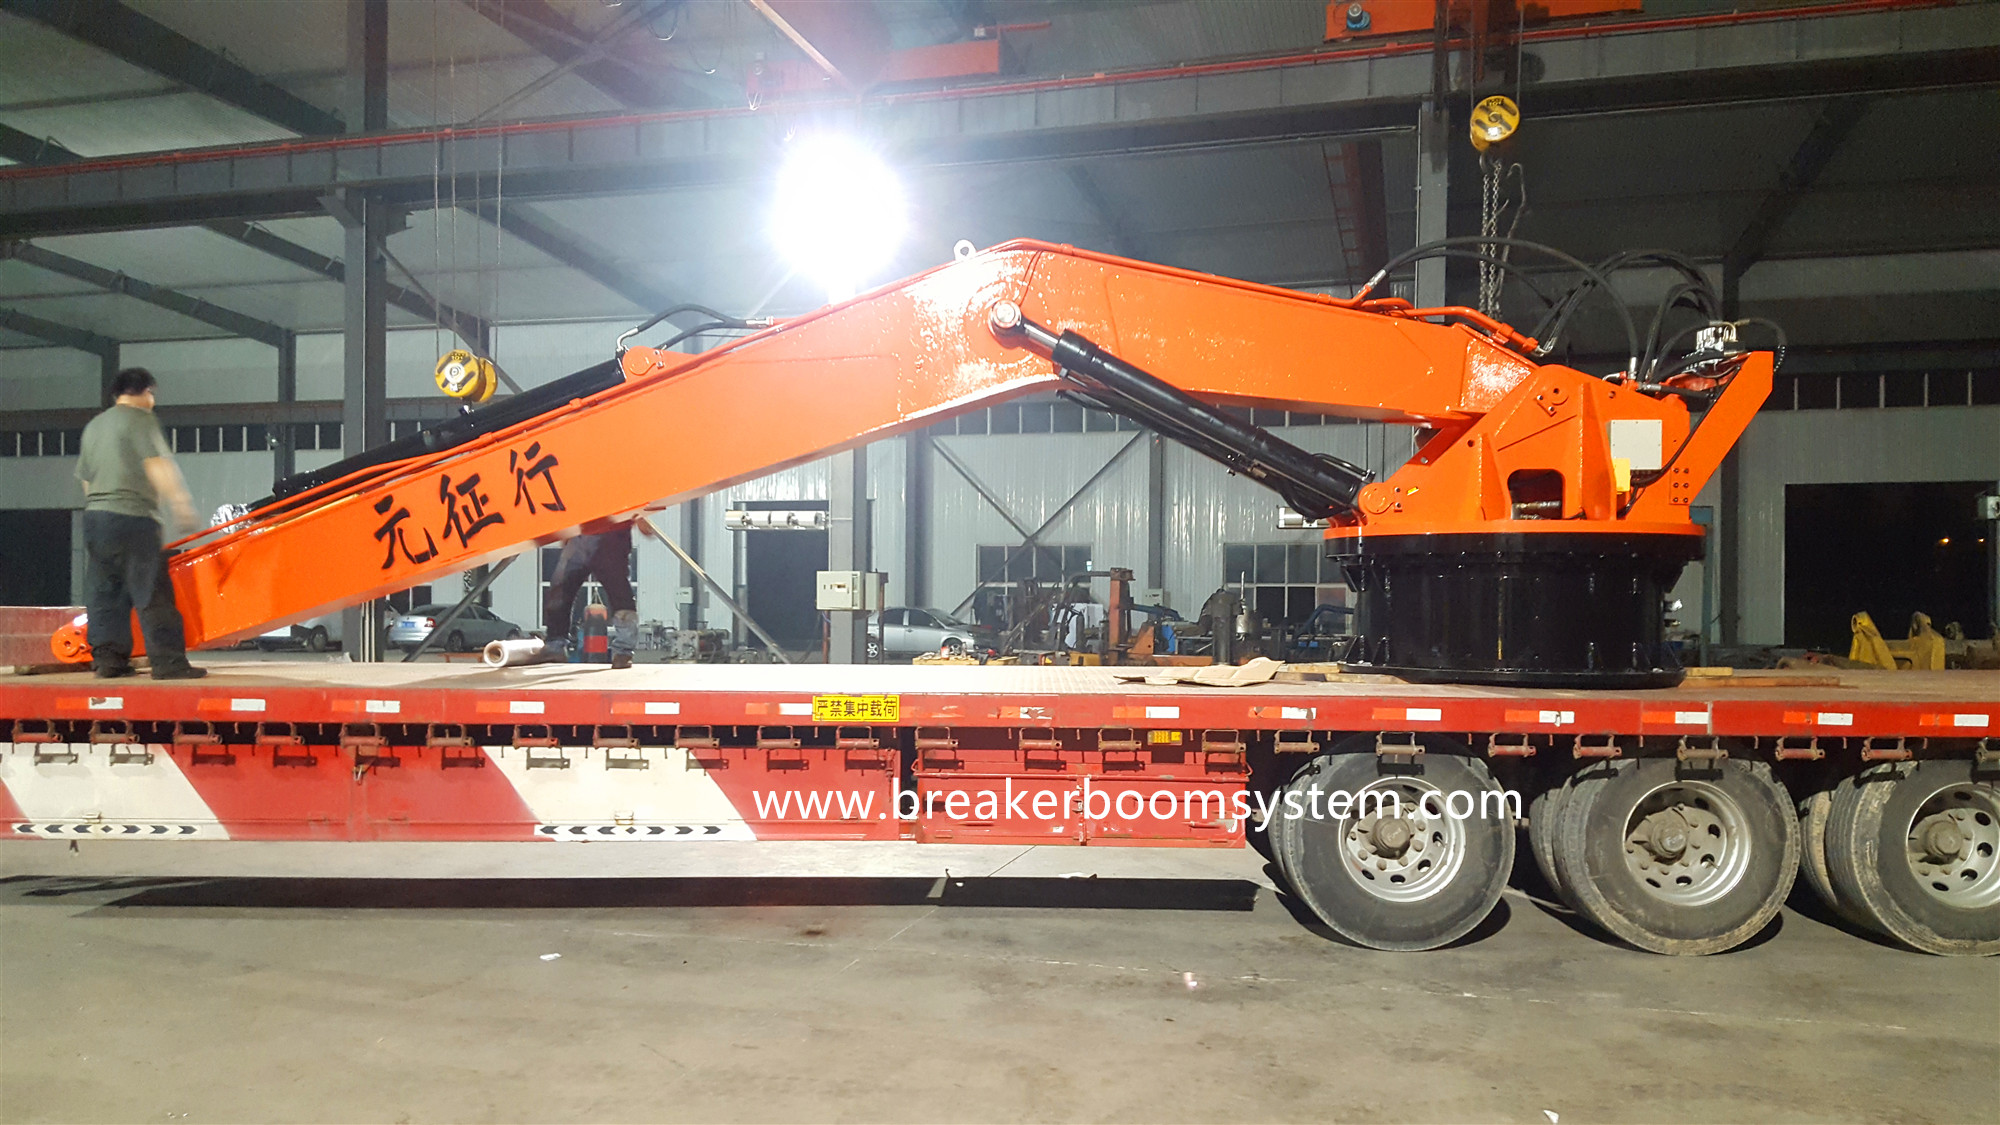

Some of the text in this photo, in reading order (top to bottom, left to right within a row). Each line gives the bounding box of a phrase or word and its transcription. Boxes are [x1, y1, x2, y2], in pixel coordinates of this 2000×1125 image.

[373, 441, 567, 570] 元征行
[817, 699, 897, 717] 严禁集中载荷
